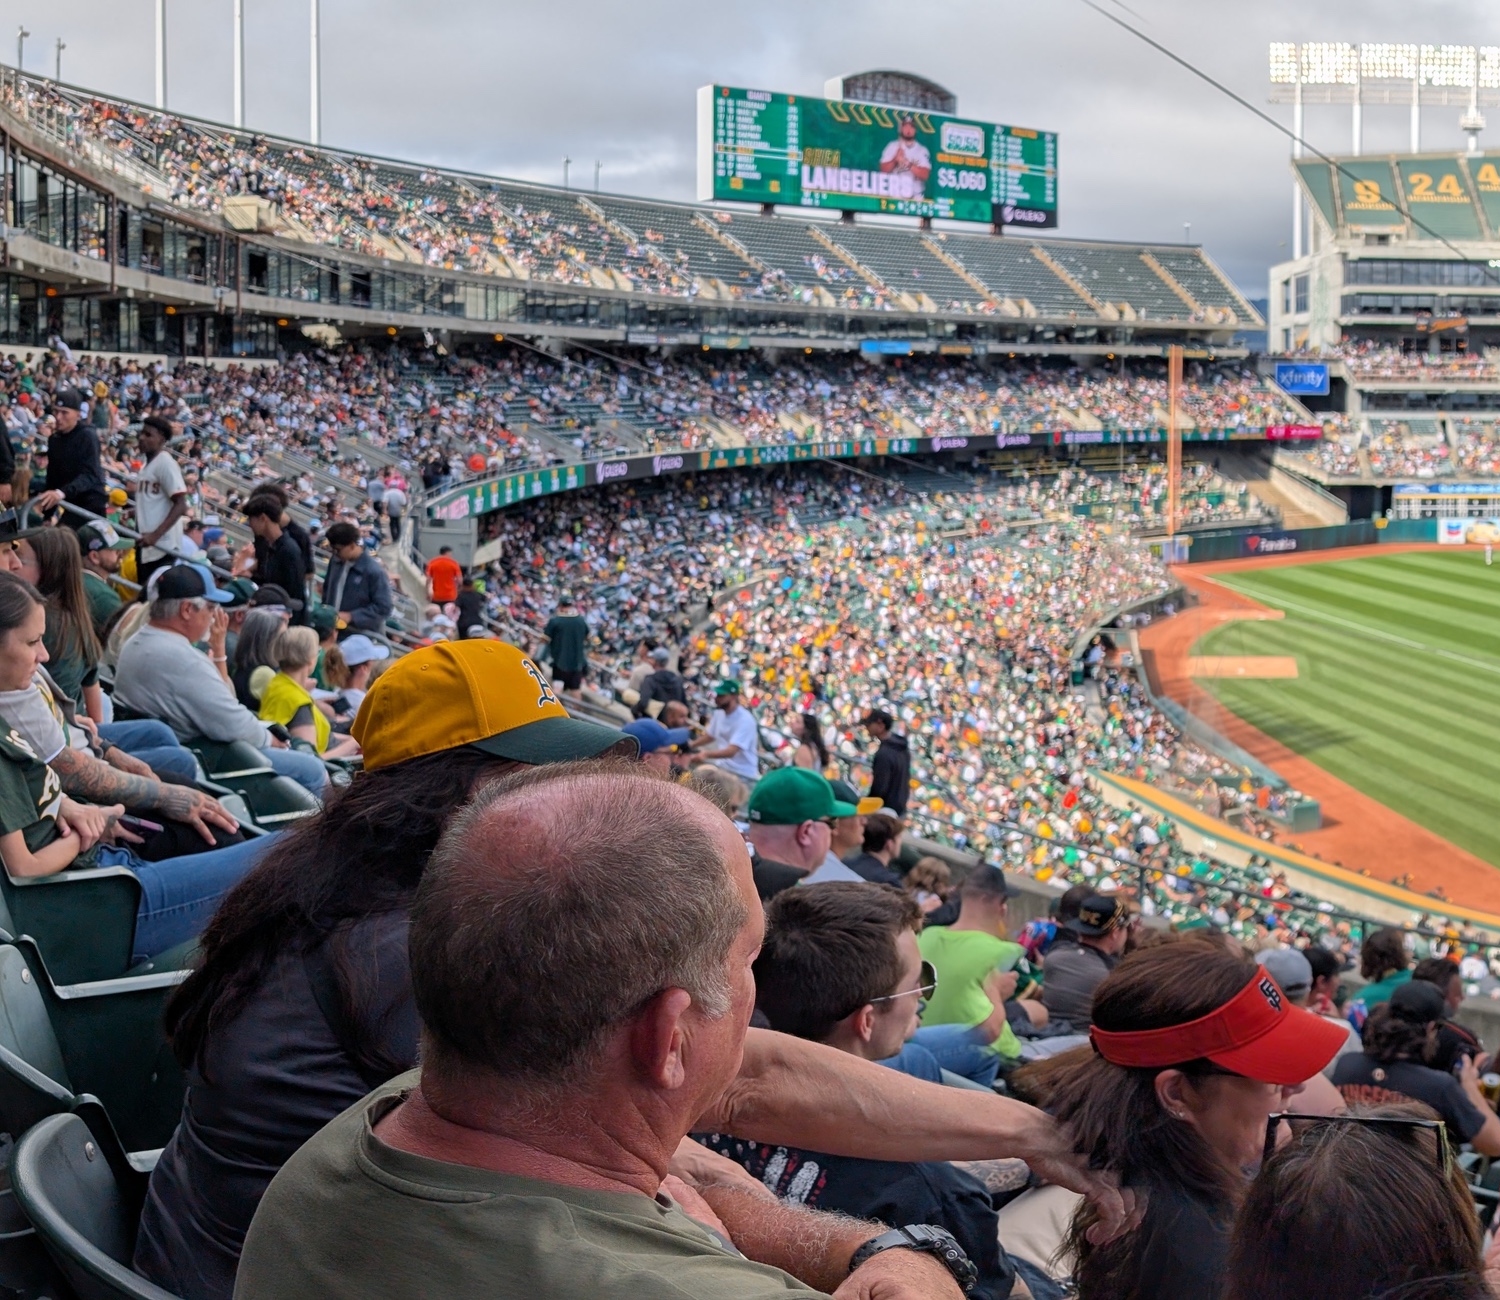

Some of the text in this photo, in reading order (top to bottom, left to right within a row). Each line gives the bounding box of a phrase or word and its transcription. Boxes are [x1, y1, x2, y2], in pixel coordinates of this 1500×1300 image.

[802, 166, 914, 199] LANGELIERS
[1408, 173, 1465, 197] 24
[1280, 365, 1325, 391] xfinity
